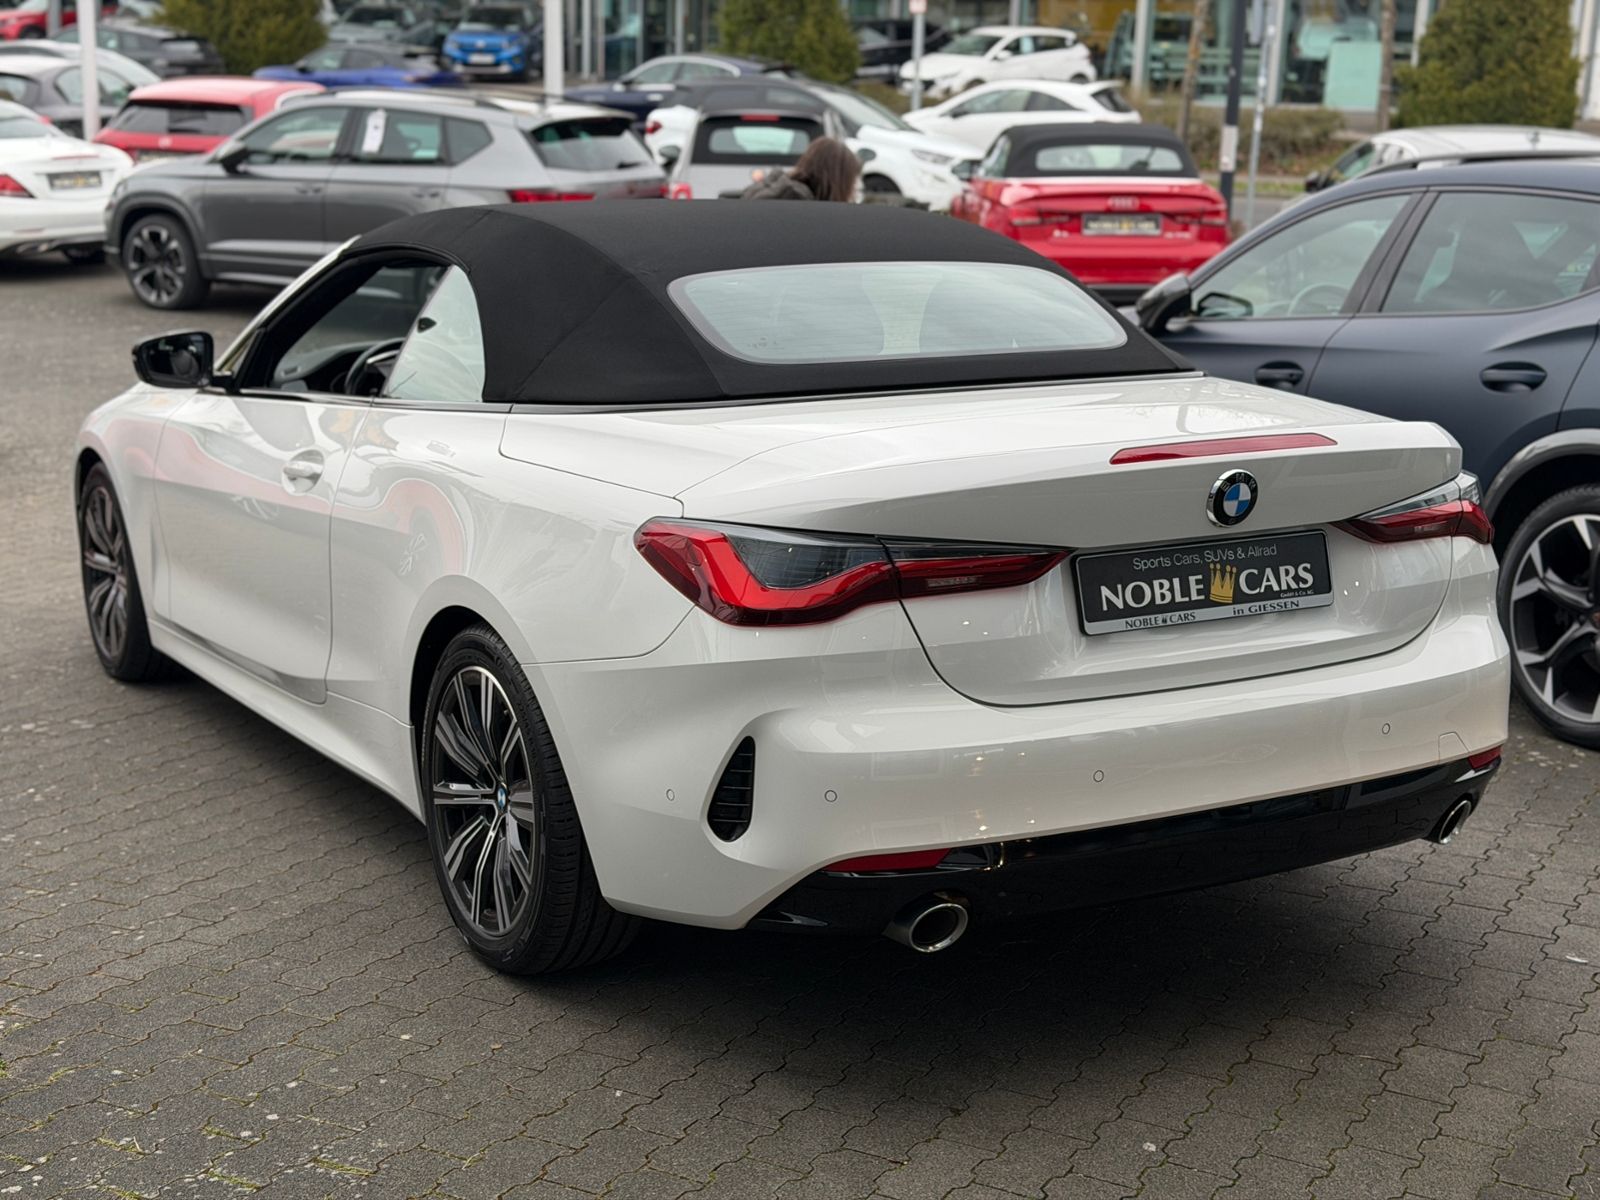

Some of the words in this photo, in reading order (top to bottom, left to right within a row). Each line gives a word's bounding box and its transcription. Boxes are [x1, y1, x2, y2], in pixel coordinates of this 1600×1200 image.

[1133, 556, 1171, 571] Sports
[1173, 553, 1203, 566] Cars,
[1204, 549, 1235, 562] SUVs
[1237, 547, 1246, 559] &
[1248, 544, 1277, 558] Allrad
[1100, 574, 1205, 611] NOBLE
[1239, 563, 1314, 594] CARS
[1233, 606, 1245, 615] in
[1248, 600, 1299, 614] GIESSEN
[1125, 616, 1160, 629] NOBLE
[1170, 612, 1196, 623] CARS
